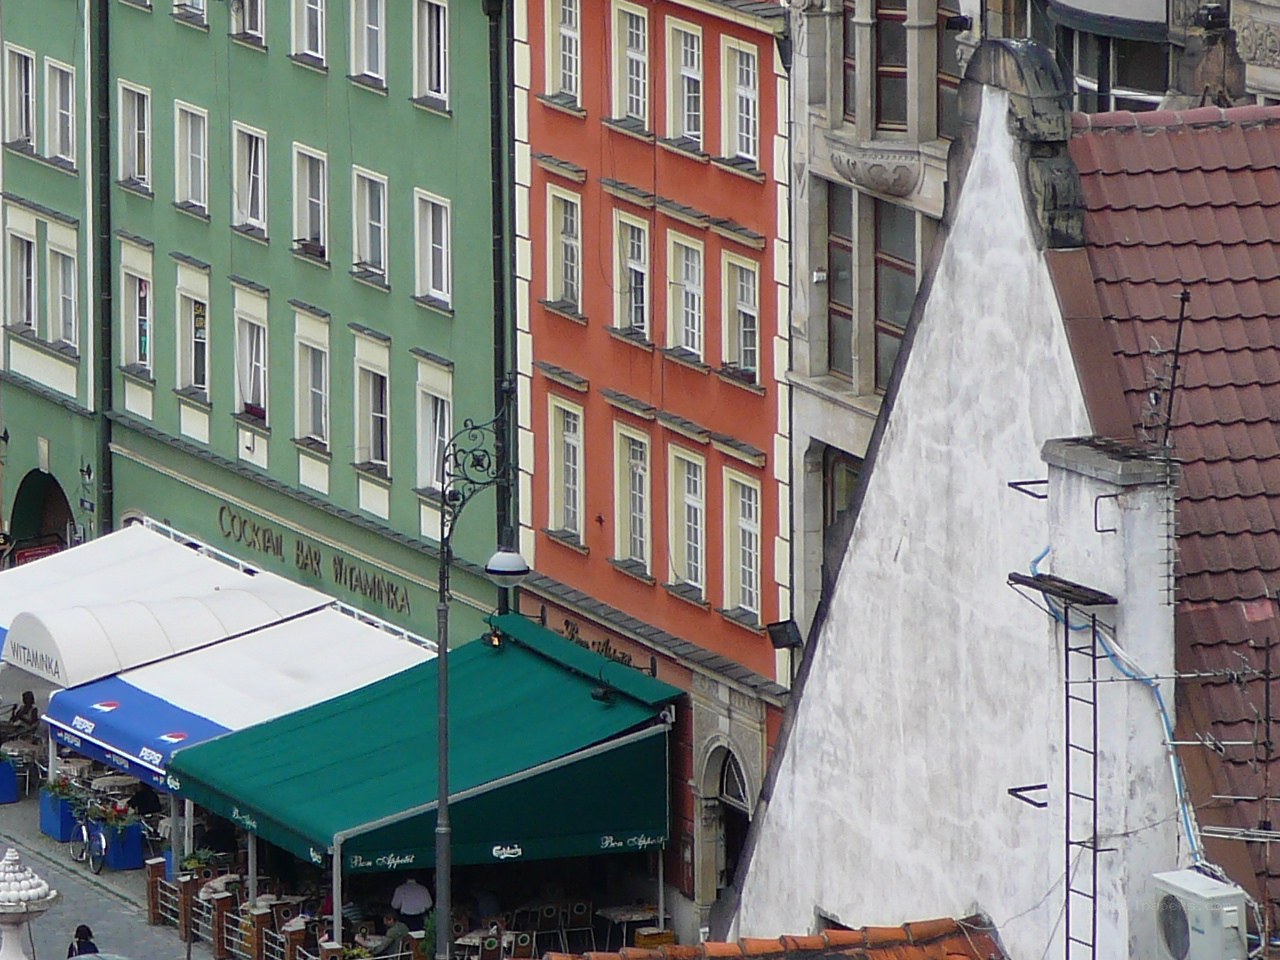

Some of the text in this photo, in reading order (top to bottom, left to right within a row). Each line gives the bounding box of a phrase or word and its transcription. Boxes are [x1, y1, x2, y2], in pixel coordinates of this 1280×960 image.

[219, 504, 411, 616] COCKTAIL BAR WITAMINKA
[10, 640, 61, 680] WITAMINKA
[72, 715, 96, 734] PEPSI
[138, 746, 163, 766] PEPSI
[350, 855, 372, 869] Bon
